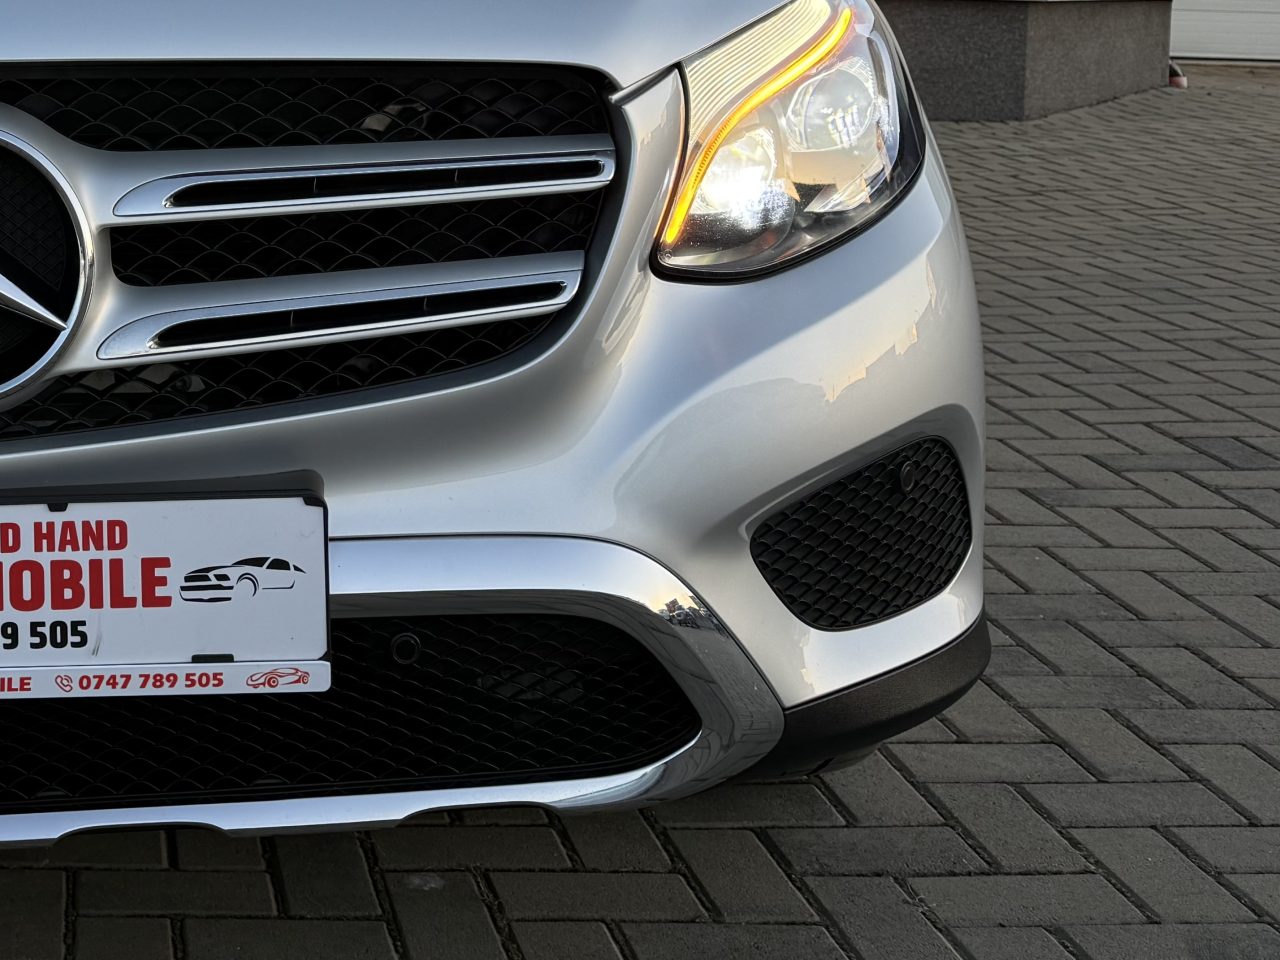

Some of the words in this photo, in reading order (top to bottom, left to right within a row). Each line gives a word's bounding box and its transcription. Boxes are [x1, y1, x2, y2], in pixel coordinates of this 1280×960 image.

[33, 519, 129, 553] HAND
[29, 620, 89, 650] 505
[77, 673, 132, 691] 0747
[138, 672, 179, 690] 789
[183, 671, 225, 689] 505
